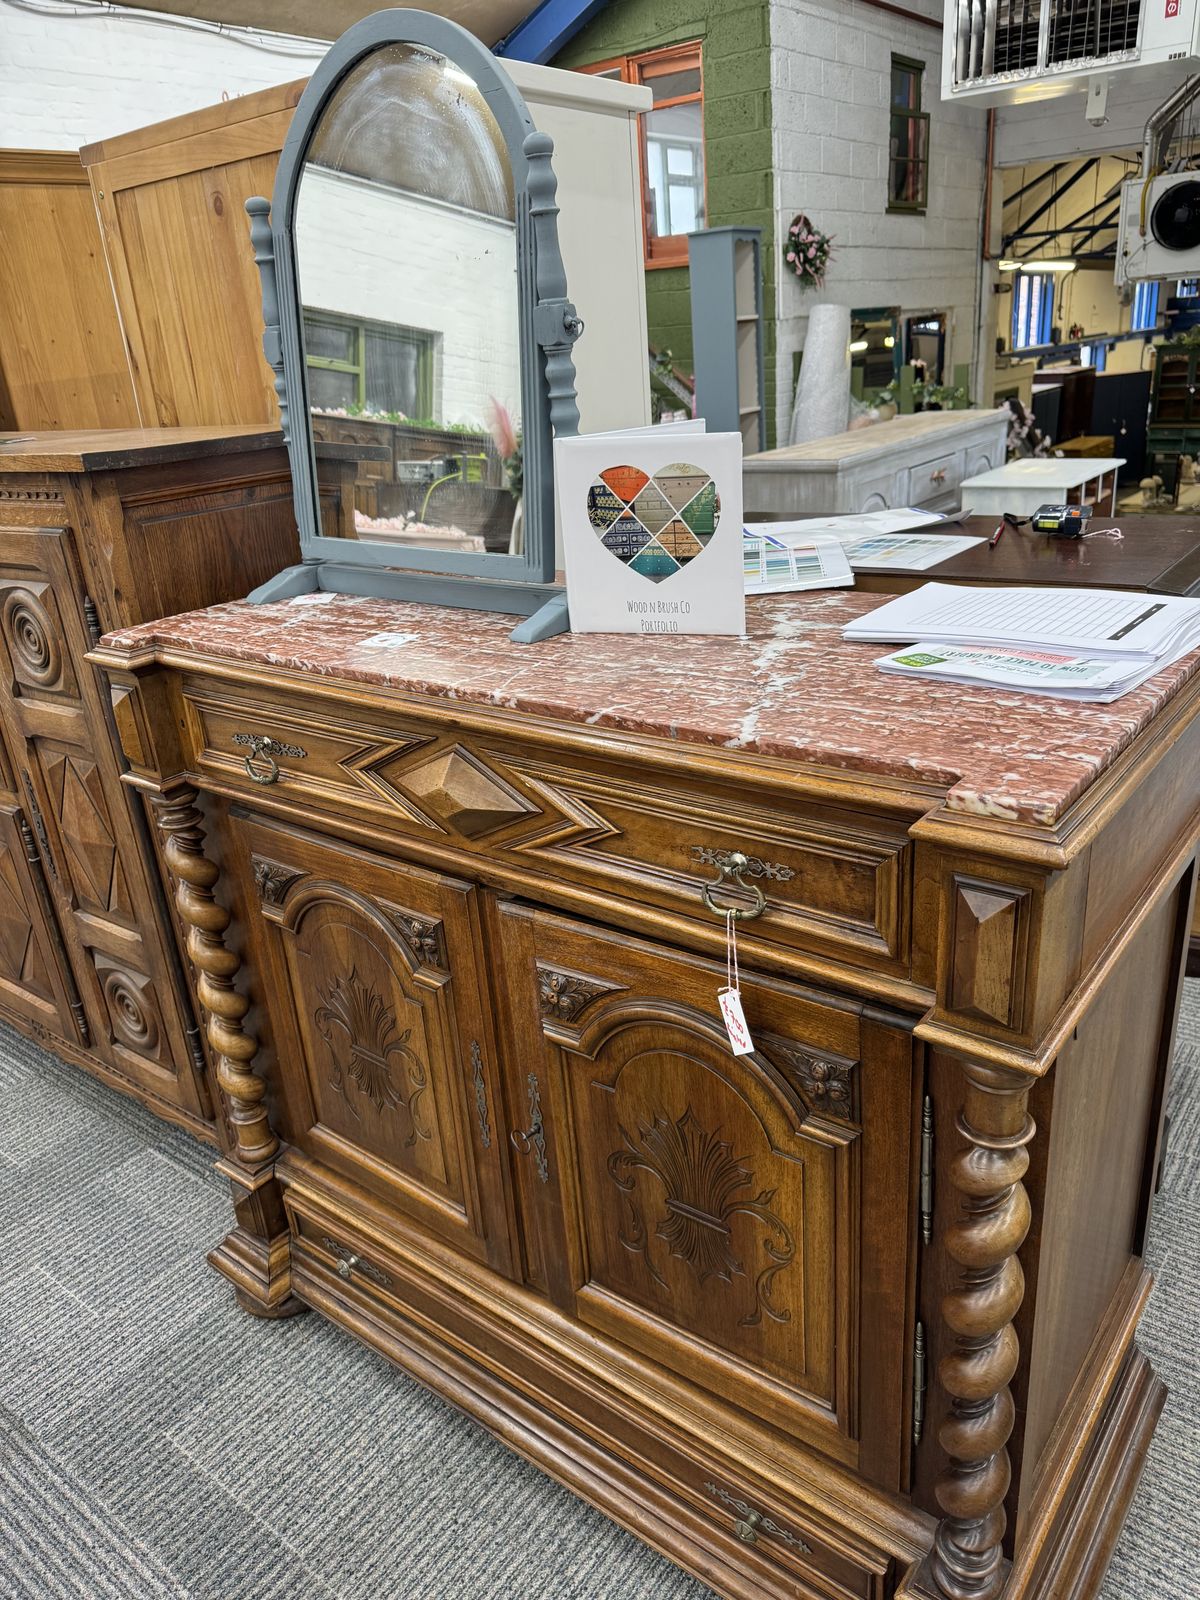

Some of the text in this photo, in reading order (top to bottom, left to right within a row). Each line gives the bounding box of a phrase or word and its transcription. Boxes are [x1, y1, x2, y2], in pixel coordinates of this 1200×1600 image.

[640, 619, 679, 632] PORTFOLIO
[1006, 656, 1040, 667] PLACE
[1057, 665, 1088, 673] HOW
